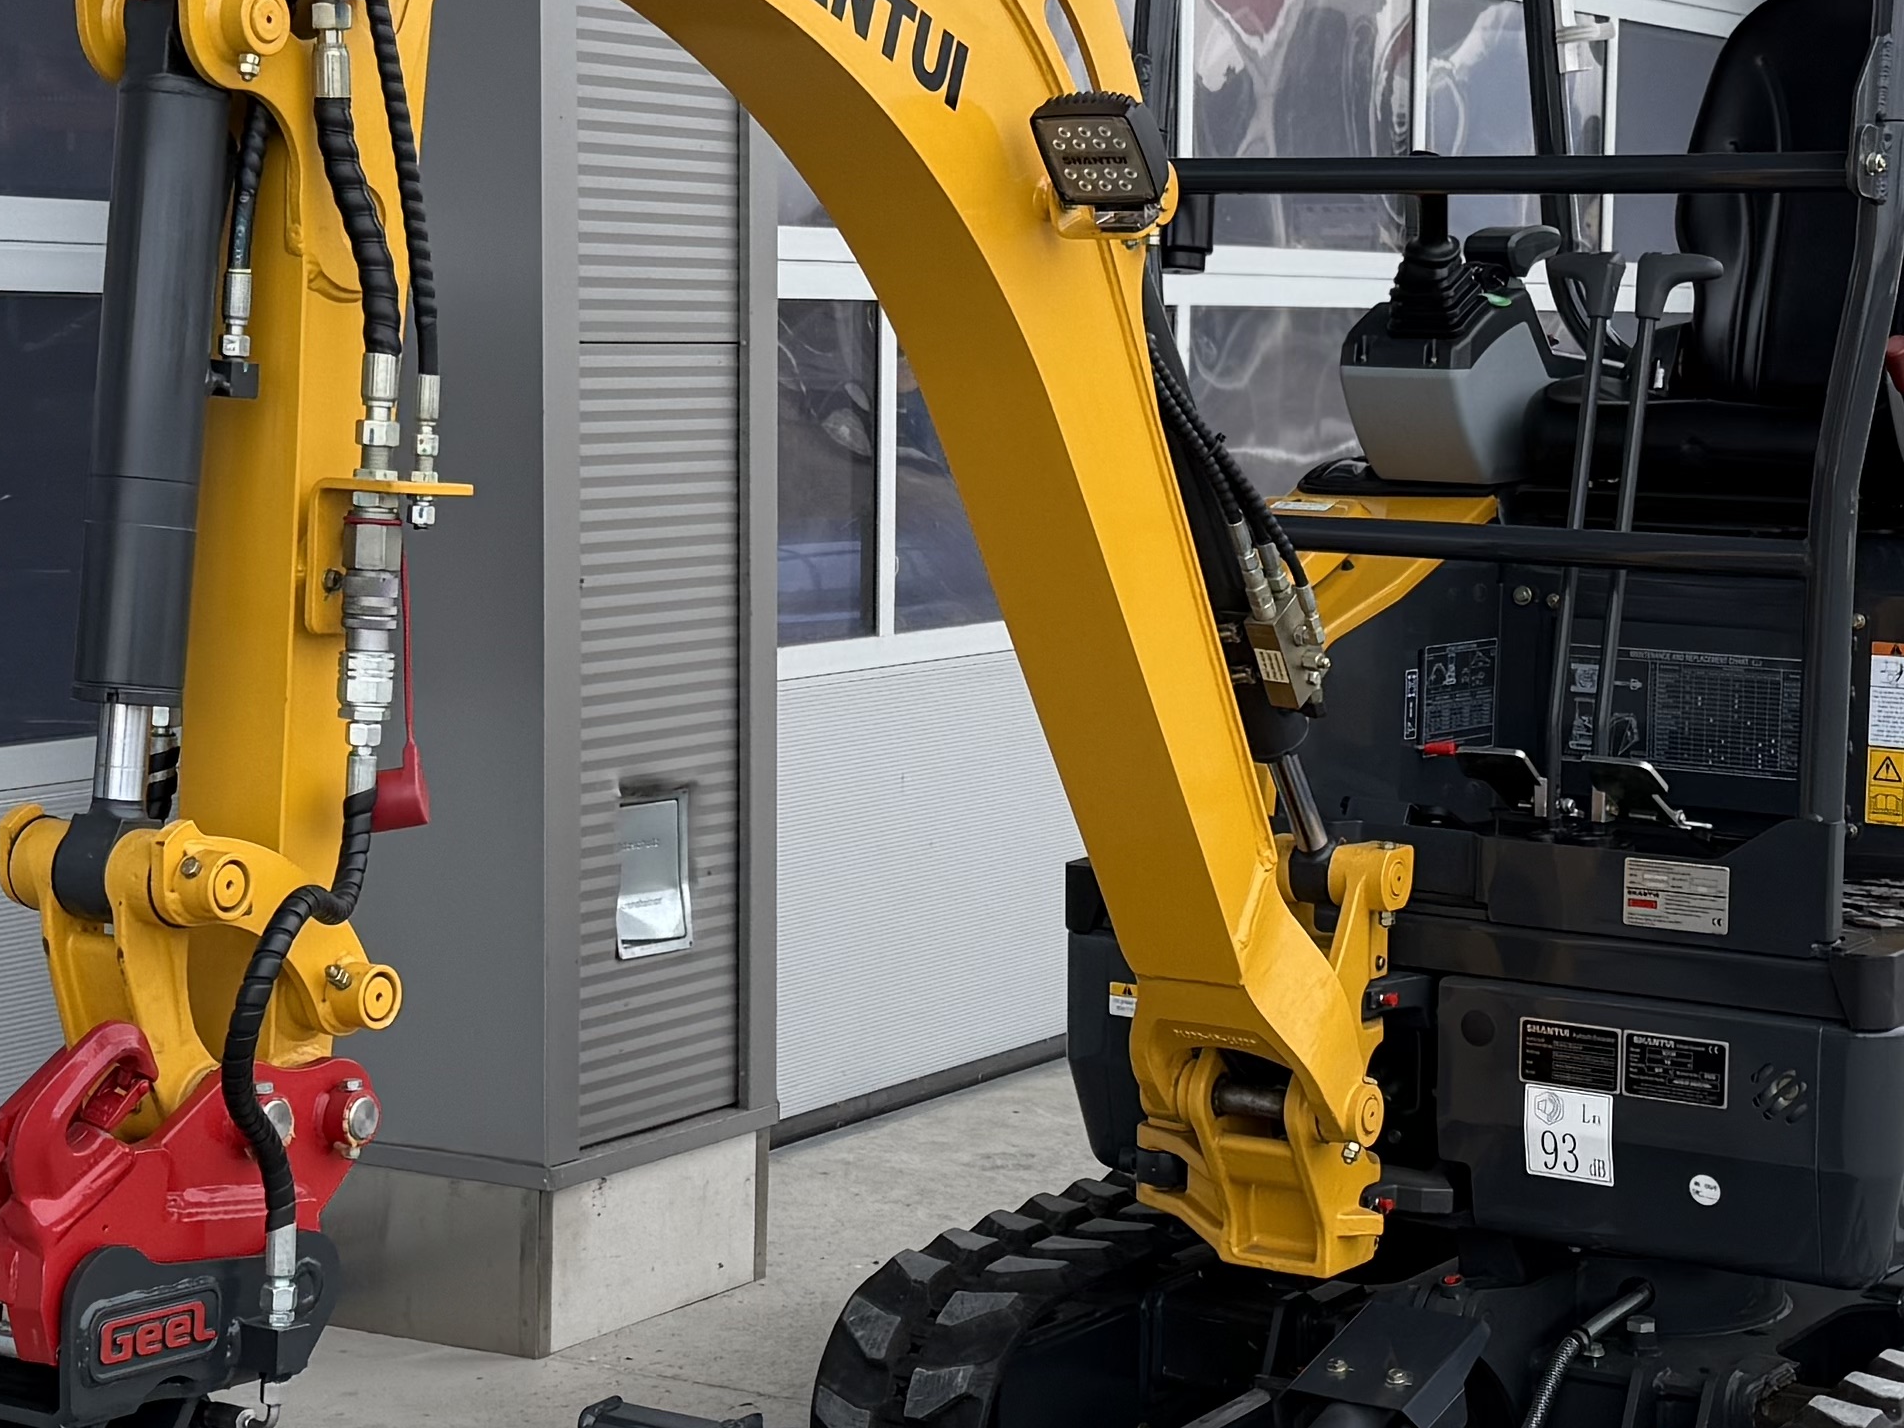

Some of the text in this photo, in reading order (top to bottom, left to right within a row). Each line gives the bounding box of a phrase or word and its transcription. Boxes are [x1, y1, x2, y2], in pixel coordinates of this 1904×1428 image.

[1062, 155, 1129, 166] SHANTUI
[1526, 1024, 1570, 1037] SHANTUI
[1540, 1130, 1579, 1173] 93
[1589, 1158, 1606, 1178] dB
